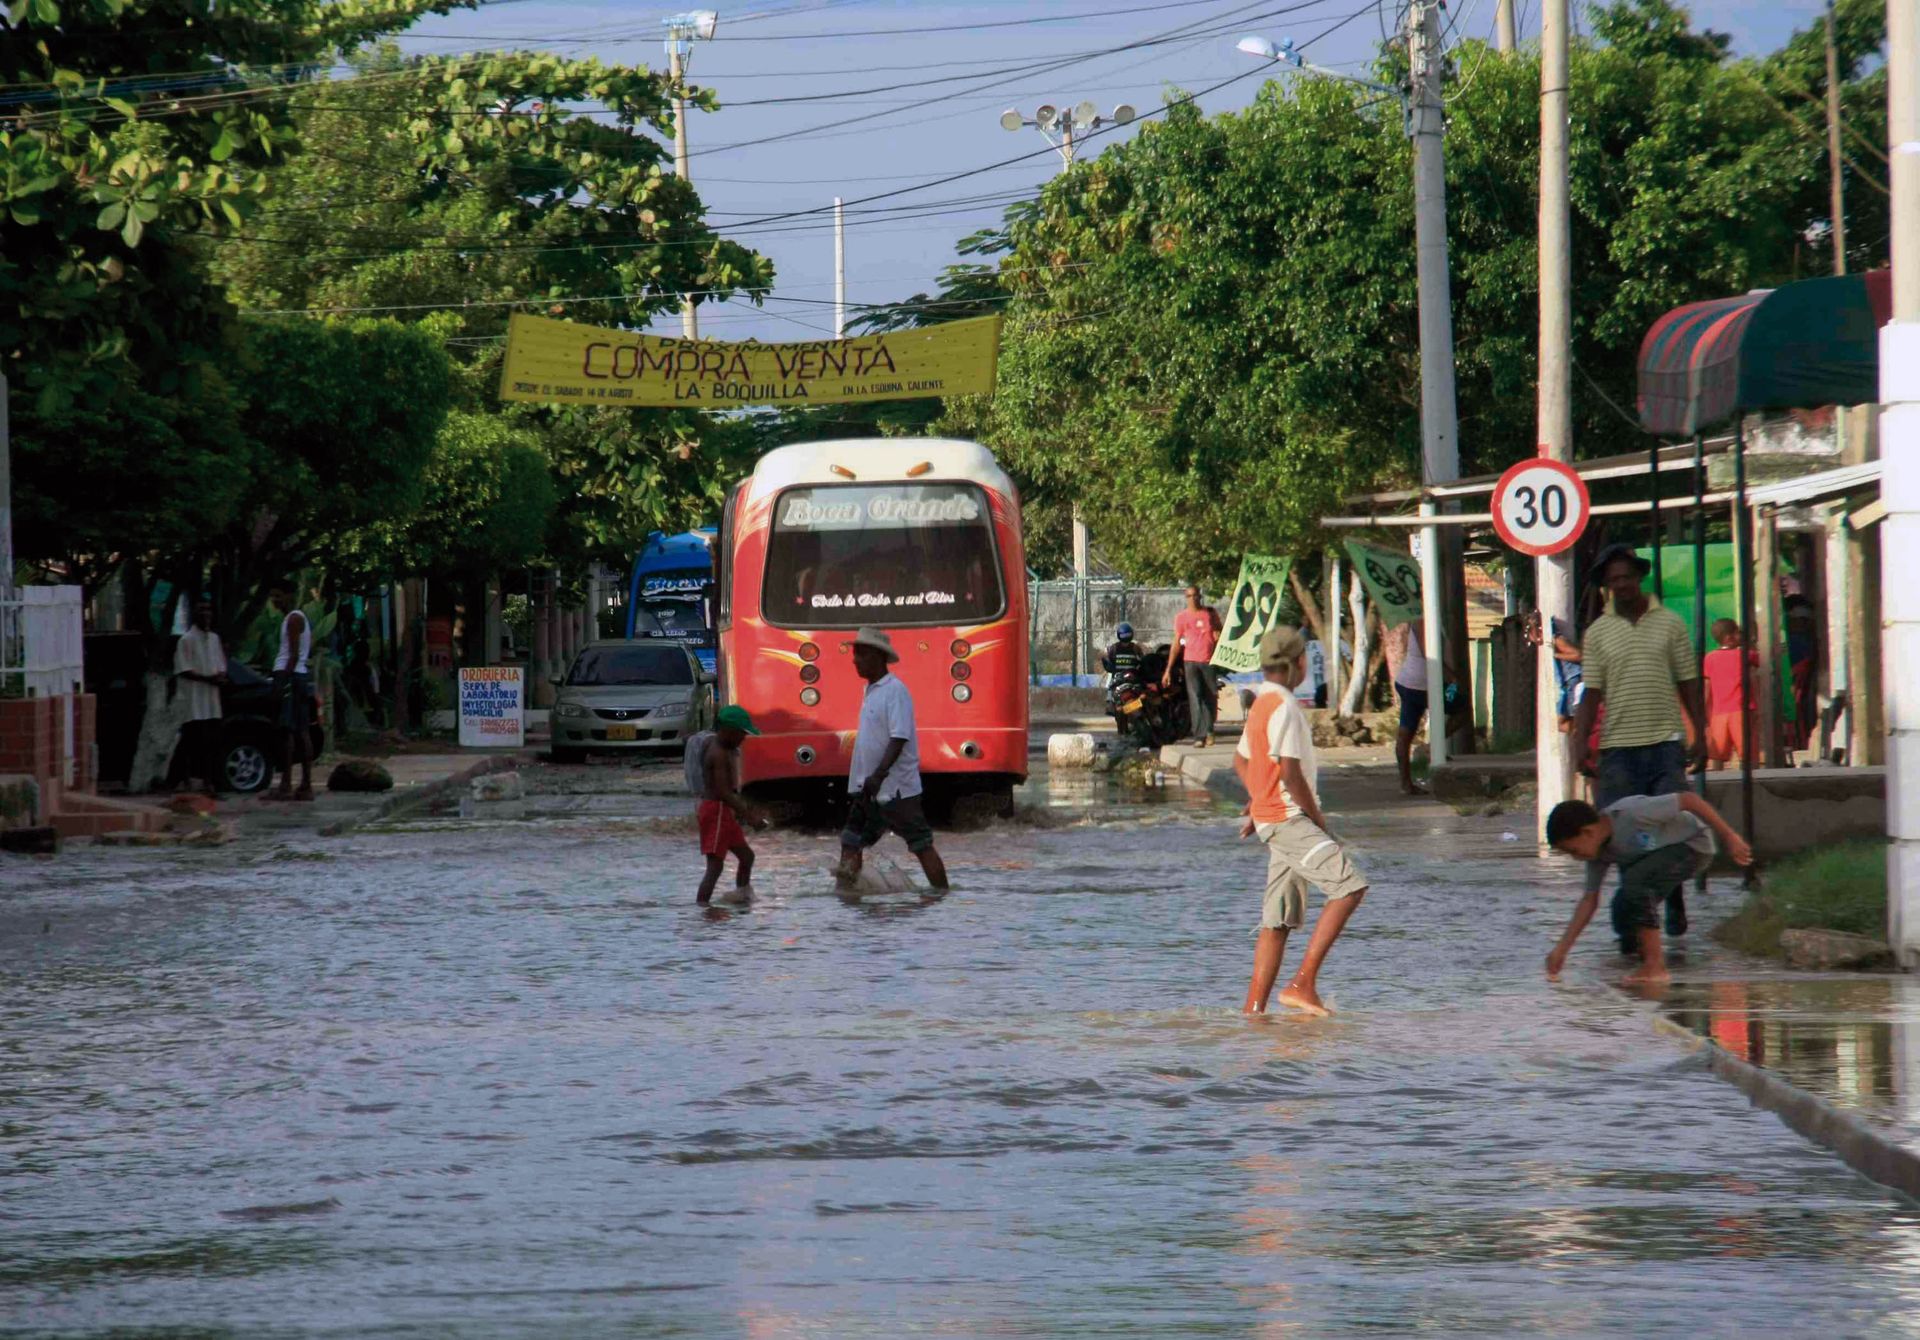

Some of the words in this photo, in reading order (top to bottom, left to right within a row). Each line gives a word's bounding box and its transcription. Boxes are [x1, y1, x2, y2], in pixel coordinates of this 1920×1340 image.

[658, 337, 853, 353] PROXIMAMENTE
[583, 342, 751, 381] COMPRA
[774, 345, 897, 380] VENTA
[674, 382, 702, 400] LA
[711, 382, 809, 402] BOQUILLA
[842, 385, 854, 396] EN
[856, 384, 868, 395] LA
[870, 382, 904, 395] ESQUINA
[907, 379, 945, 392] CALIENTE
[1514, 484, 1567, 529] 30
[461, 690, 518, 700] LABORATORIO
[461, 708, 504, 718] DOMICILIO
